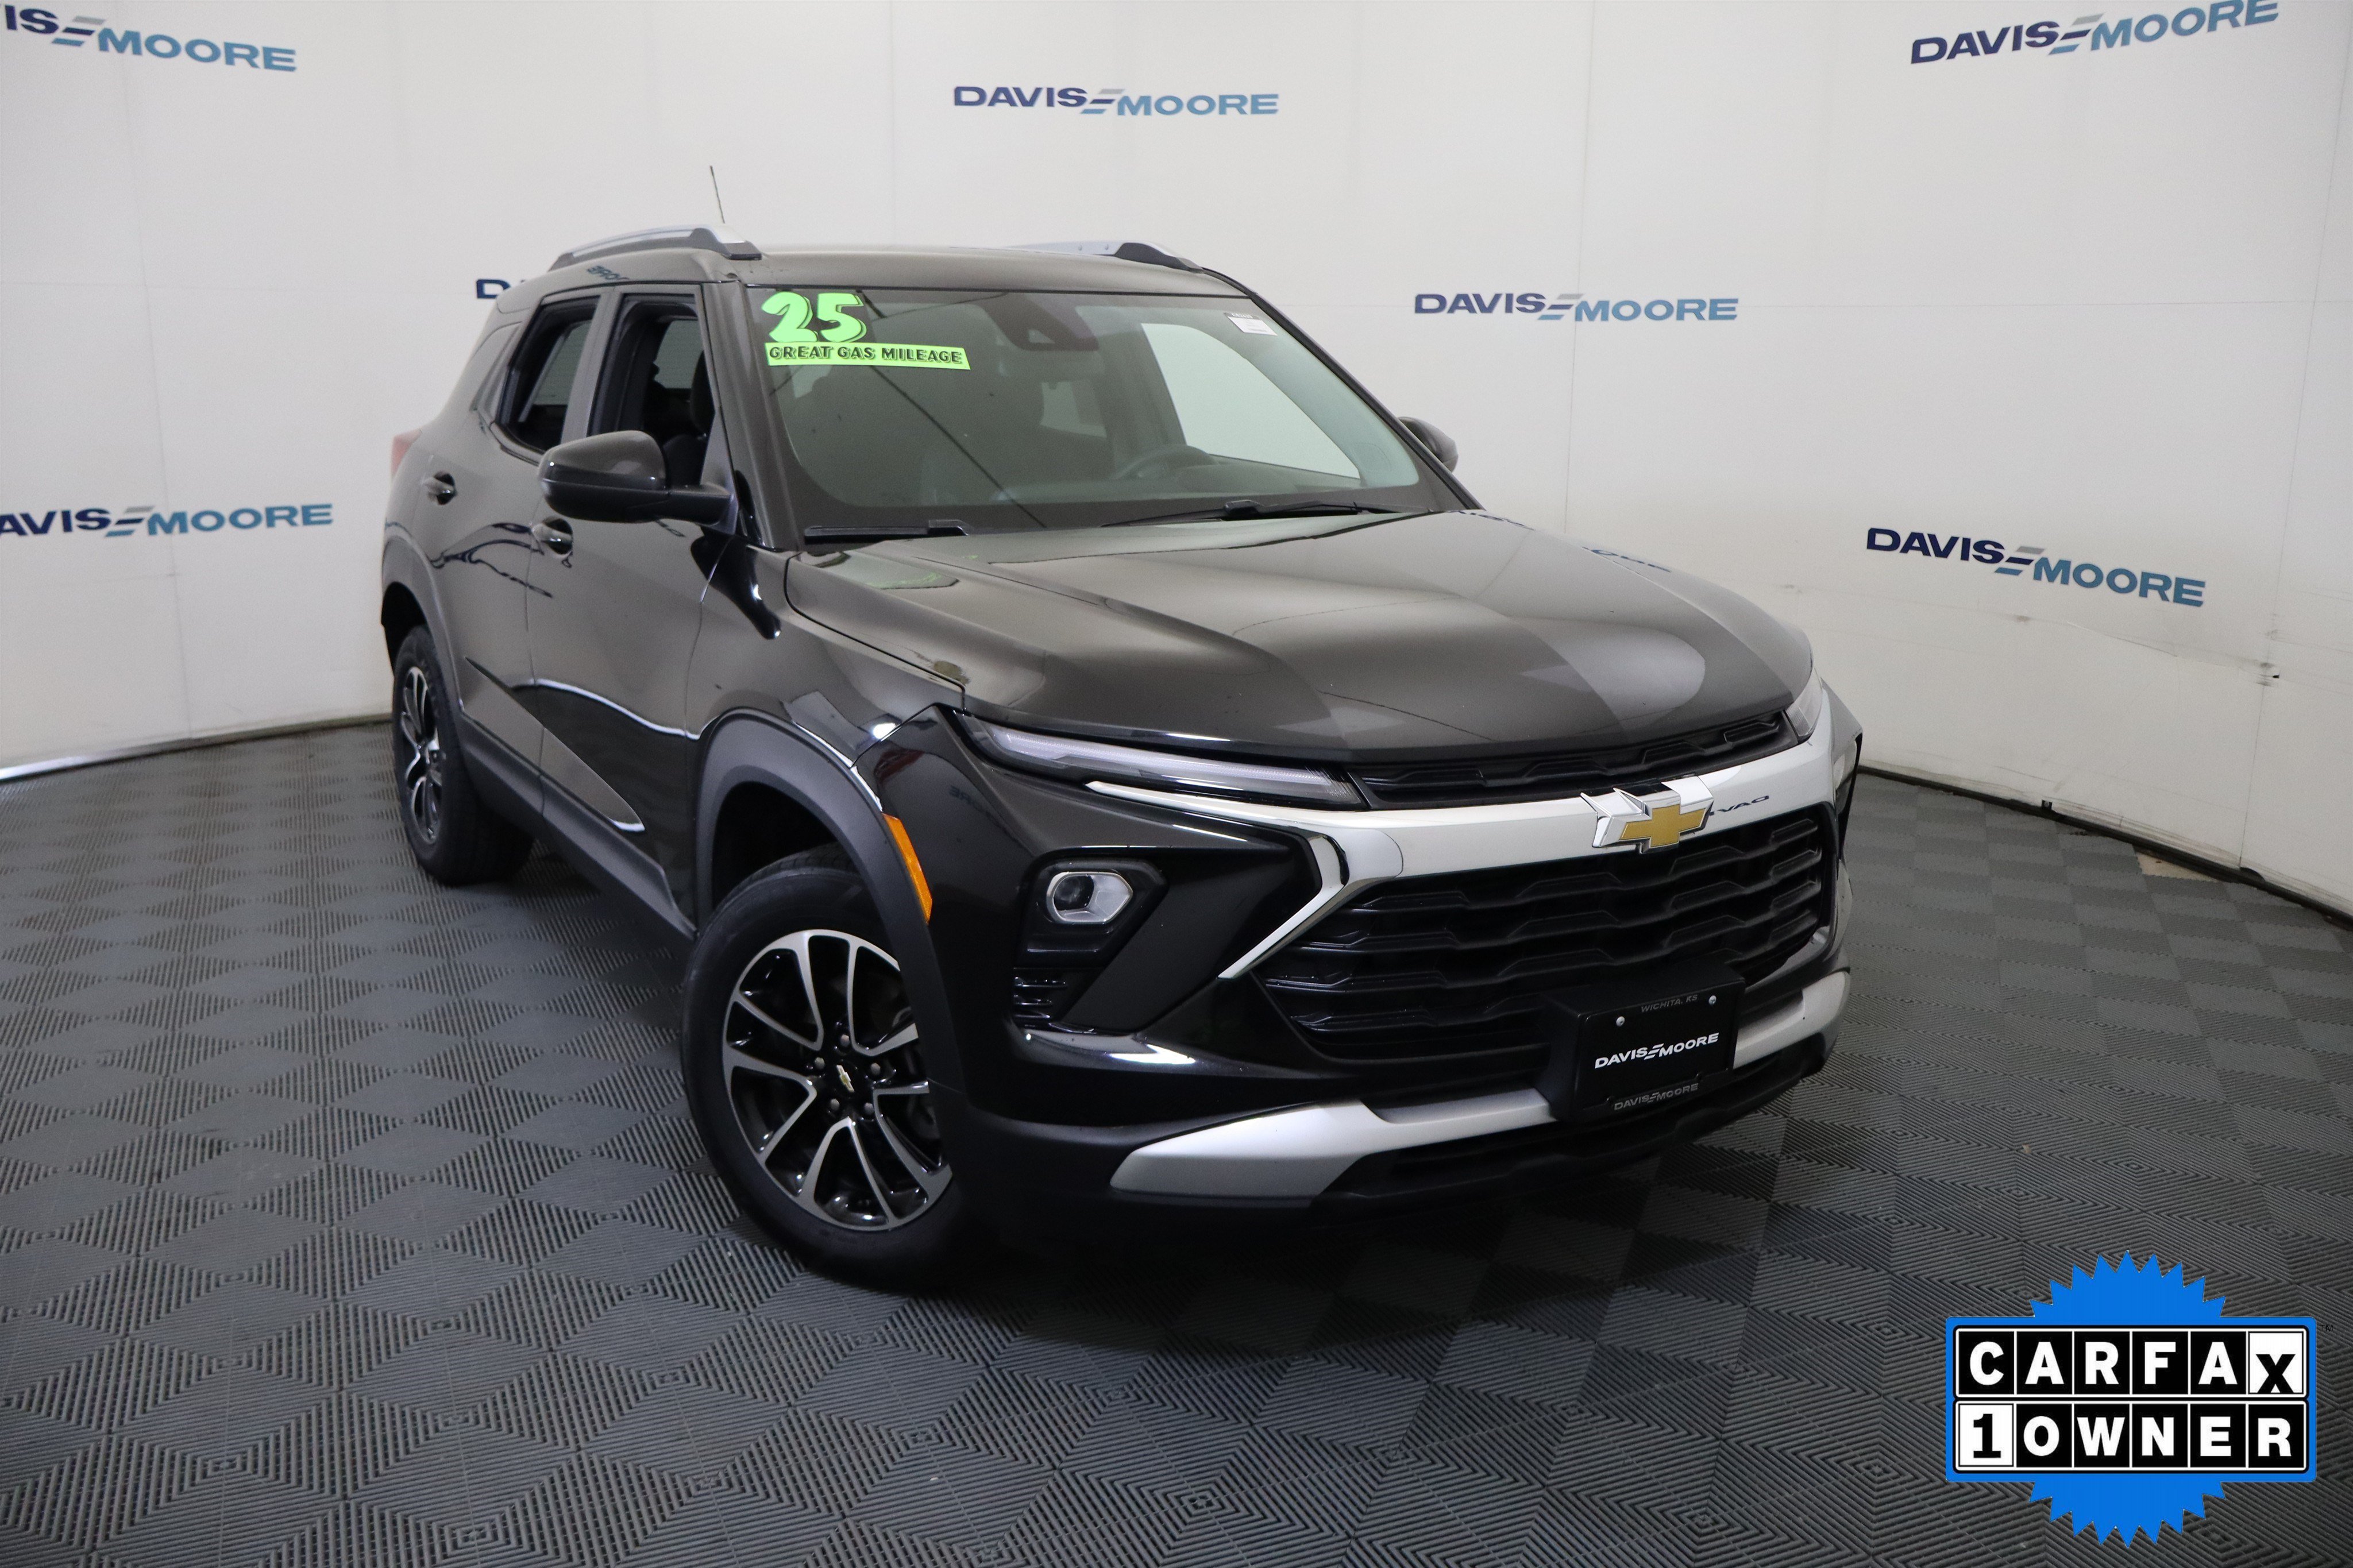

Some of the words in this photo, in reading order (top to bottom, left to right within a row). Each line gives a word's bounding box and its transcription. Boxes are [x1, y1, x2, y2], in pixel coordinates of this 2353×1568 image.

[1911, 21, 2059, 64] DAVIS
[2090, 0, 2279, 51] MOORE
[97, 28, 297, 72] MOORE
[954, 86, 1087, 108] DAVIS
[1117, 94, 1279, 115] MOORE
[761, 291, 867, 343] 25
[1414, 293, 1546, 314] DAVIS
[1575, 298, 1738, 322] MOORE
[769, 346, 833, 360] GREAT
[837, 347, 875, 360] GAS
[881, 347, 963, 364] MILEAGE
[146, 503, 333, 536] MOORE
[1866, 527, 2005, 565] DAVIS
[2033, 557, 2206, 608] MOORE
[1686, 994, 1698, 1003] KS
[1595, 1048, 1649, 1069] DAVIS
[1658, 1033, 1719, 1057] MOORE
[1614, 1095, 1650, 1110] DAVIS
[1656, 1083, 1699, 1102] MOORE
